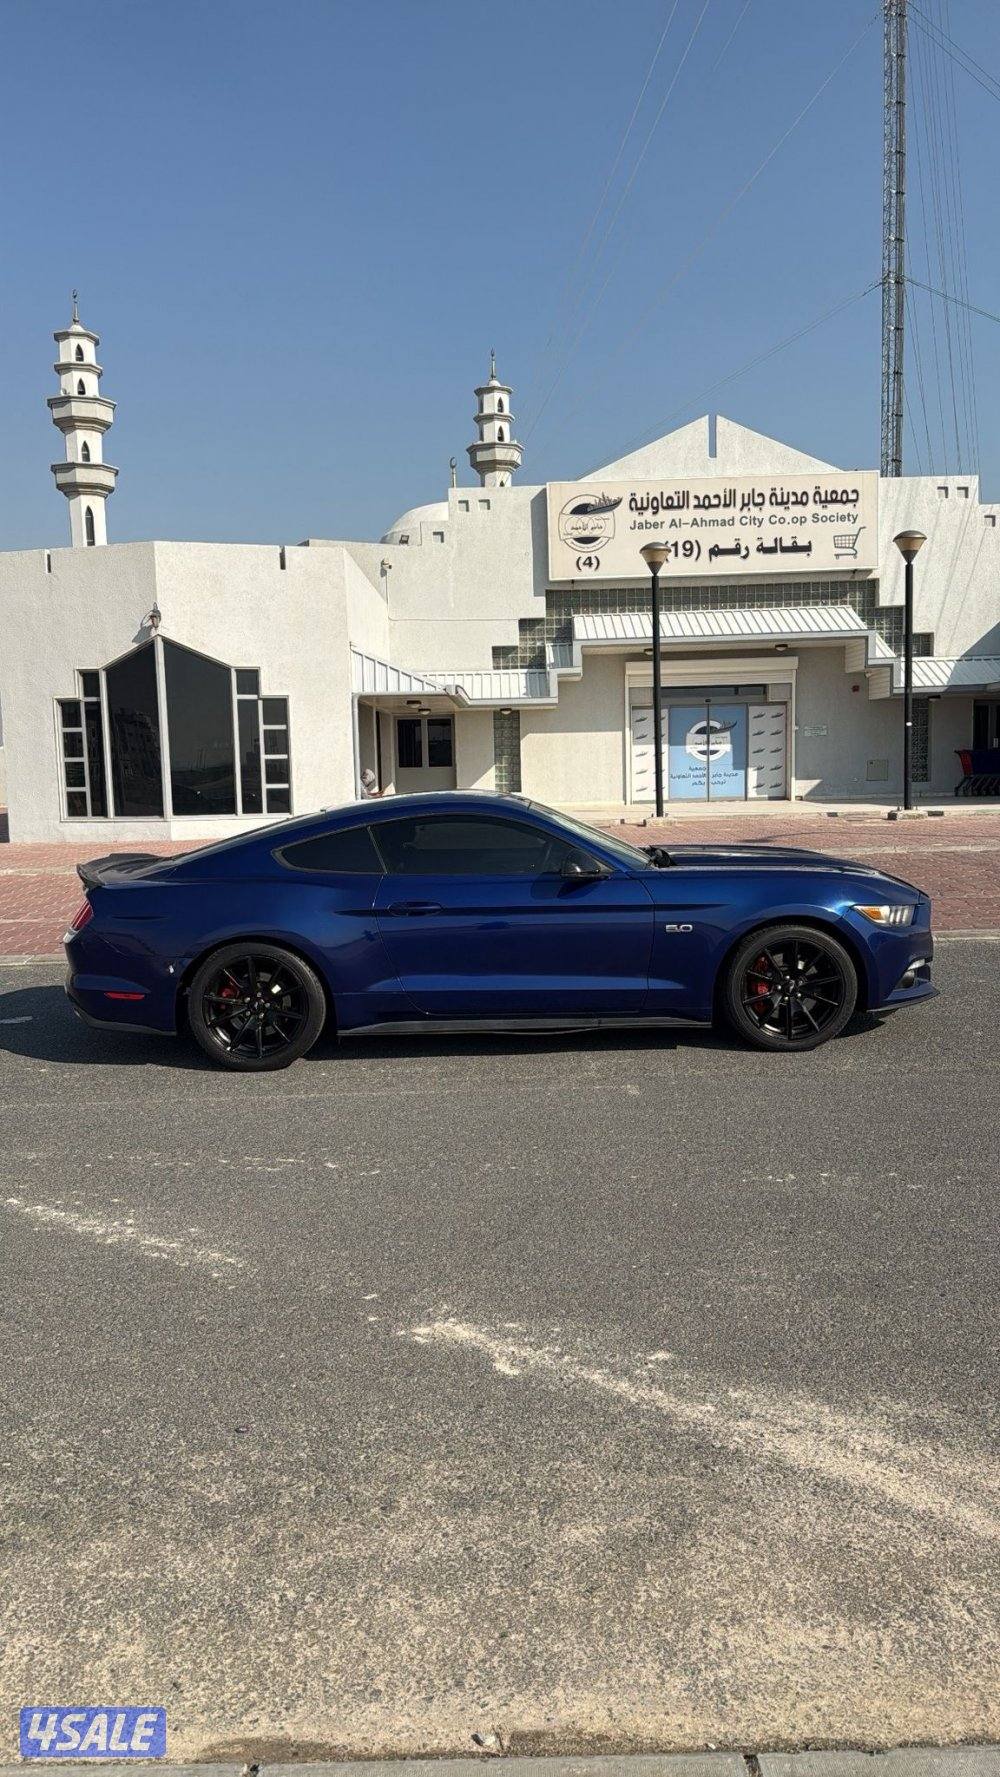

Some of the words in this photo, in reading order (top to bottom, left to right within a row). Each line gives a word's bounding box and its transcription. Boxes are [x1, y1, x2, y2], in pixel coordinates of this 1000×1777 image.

[629, 490, 690, 515] التعاونية
[693, 488, 737, 510] الأحمد
[740, 488, 765, 512] جابر
[769, 487, 809, 510] مدينة
[813, 486, 859, 509] جمعية
[630, 519, 665, 531] Jaber
[740, 515, 764, 528] City
[769, 514, 807, 528] Co.op
[812, 512, 859, 525] Society
[708, 537, 750, 563] رقم
[756, 536, 812, 556] بقالة
[576, 555, 600, 571] (4)
